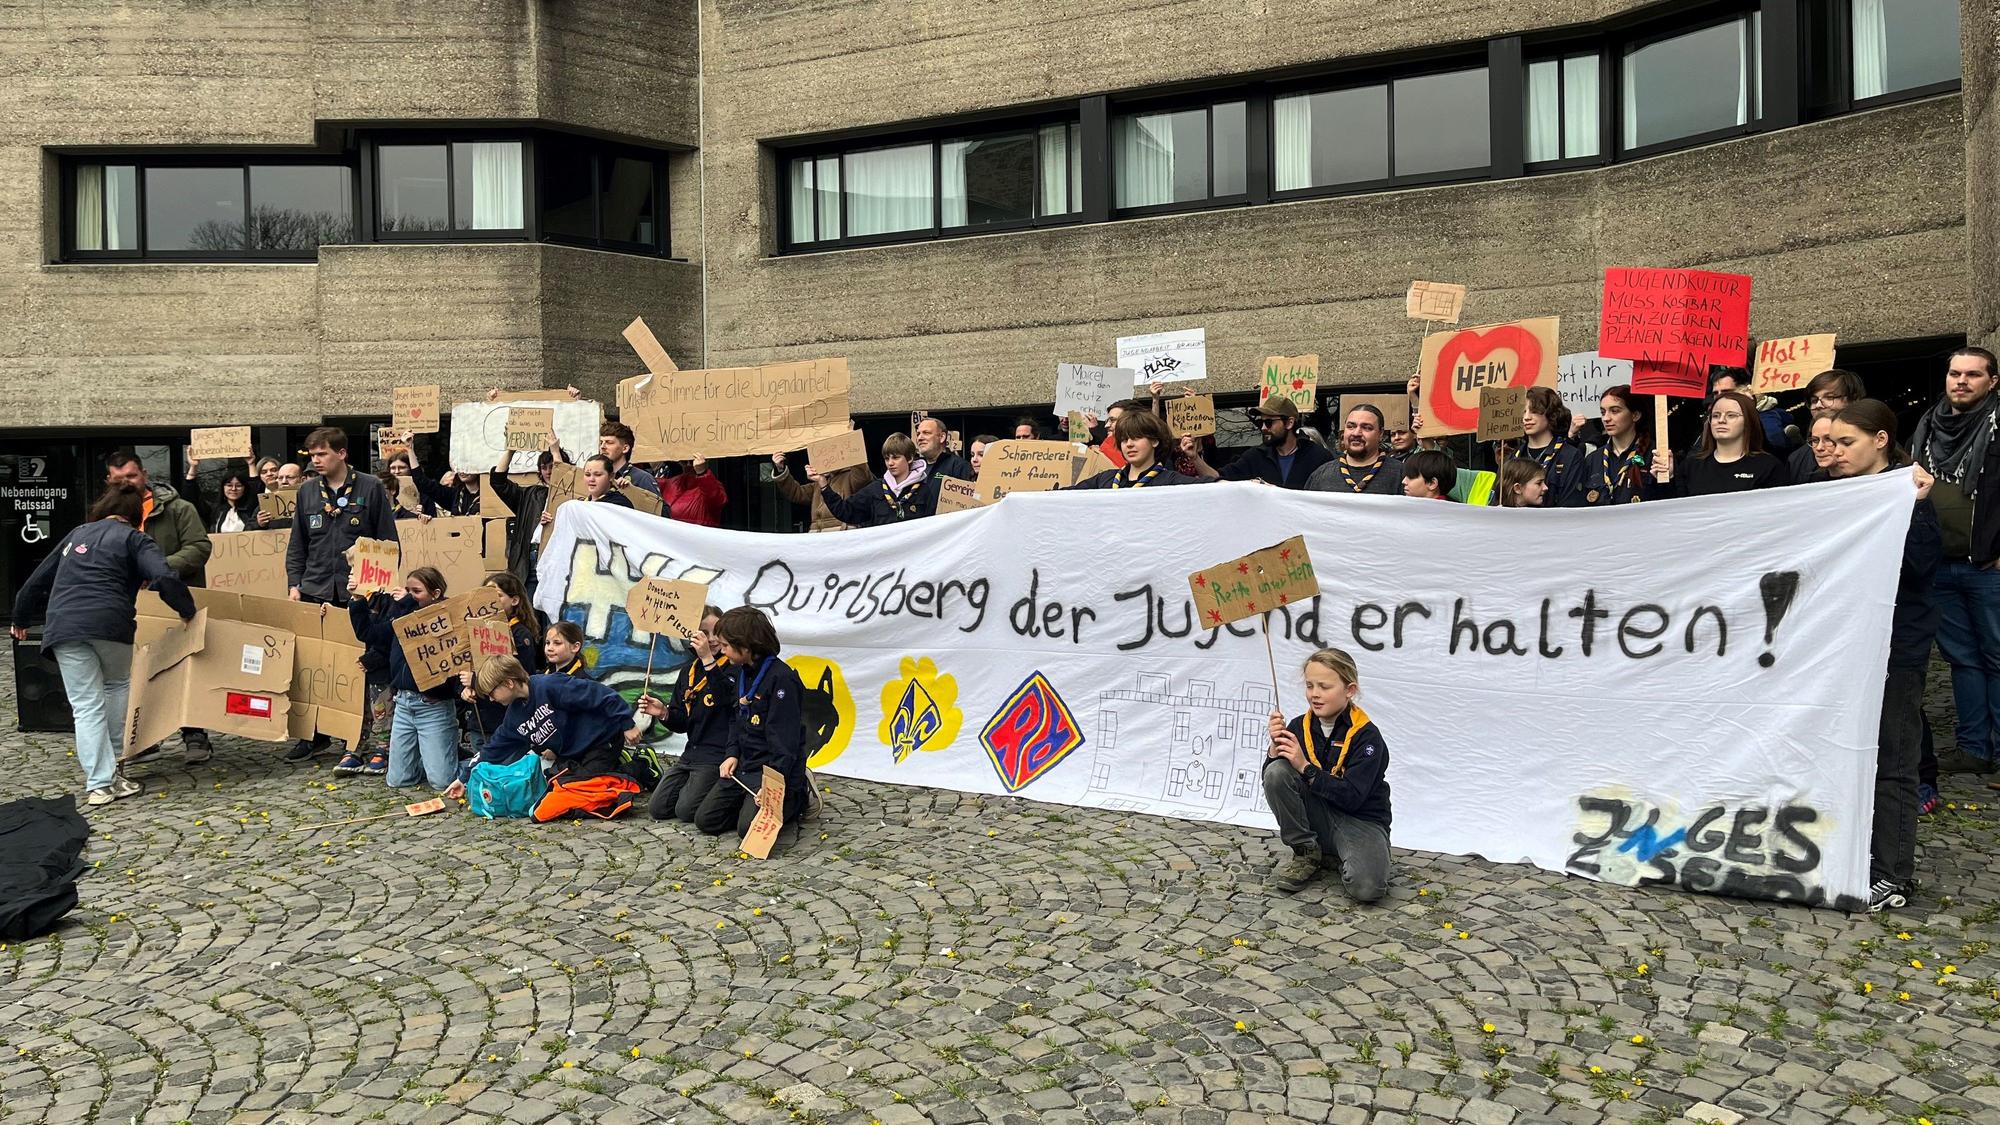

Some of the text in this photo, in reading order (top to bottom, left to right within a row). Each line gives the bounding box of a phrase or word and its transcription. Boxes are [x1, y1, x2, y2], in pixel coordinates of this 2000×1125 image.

[1614, 271, 1742, 297] JUGENDKULTUR
[1608, 291, 1723, 313] MUSS KOSTBAR
[1650, 311, 1669, 326] ZU
[1671, 311, 1722, 331] EUREN
[1606, 326, 1745, 351] PLÄNEN SAGEN WIR
[1582, 360, 1617, 379] ihr
[1640, 349, 1708, 377] NEIN
[660, 372, 700, 405] Stimme
[725, 370, 749, 398] die
[1760, 367, 1801, 389] Stop
[1483, 392, 1501, 408] Das
[706, 409, 760, 442] stimmst
[506, 432, 548, 450] VERBINDET
[1001, 467, 1021, 478] mit
[1, 486, 67, 499] Nebeneingang
[15, 499, 55, 510] Ratssaal
[360, 559, 393, 586] Heim
[1009, 568, 1097, 645] der
[417, 635, 459, 661] Heim
